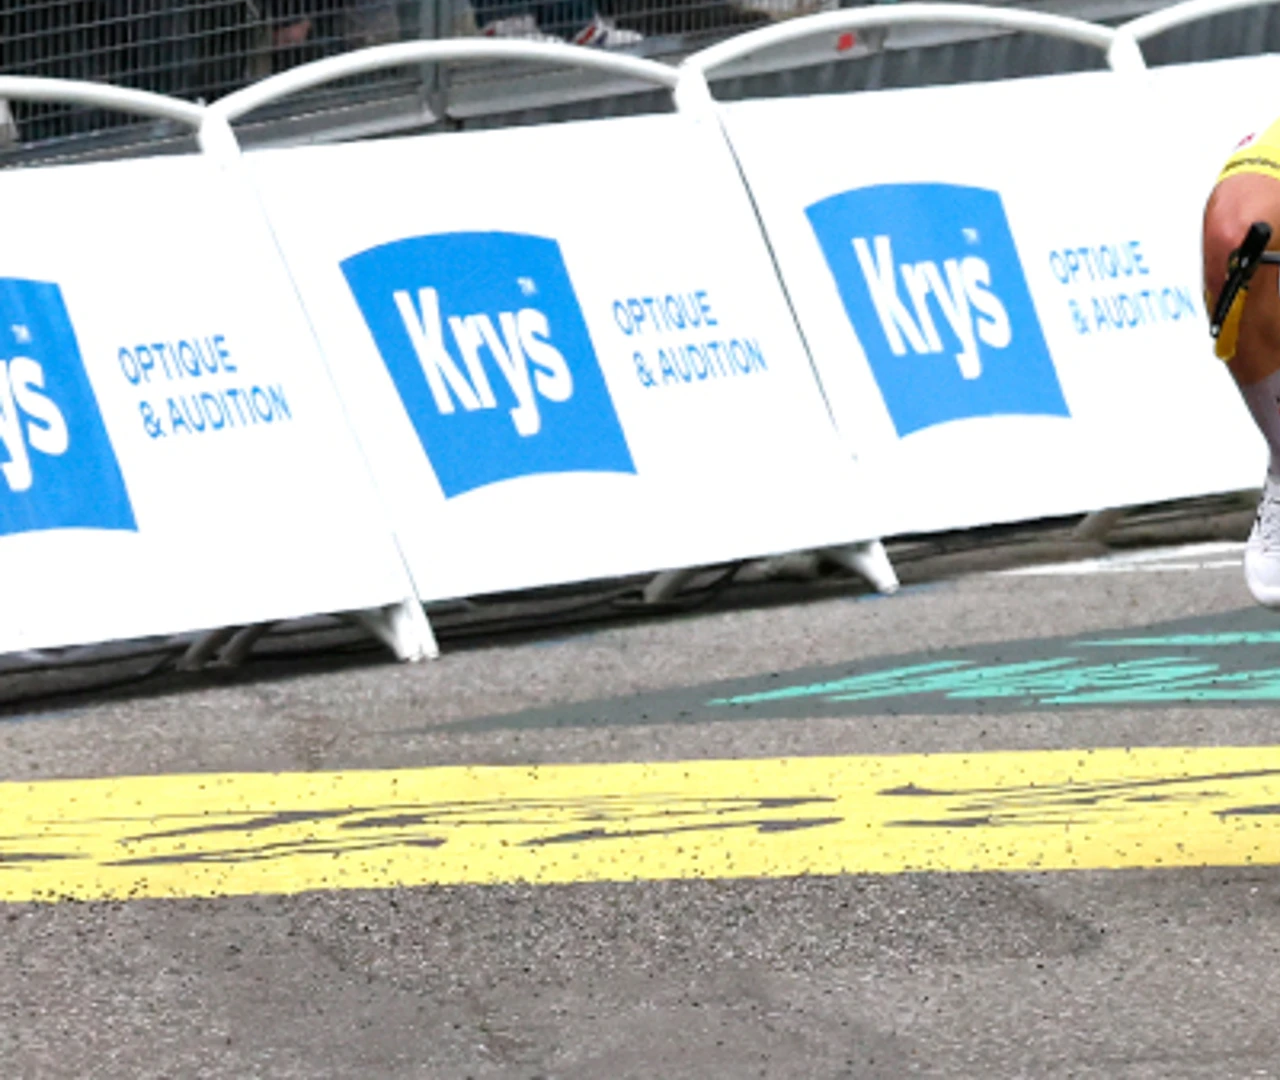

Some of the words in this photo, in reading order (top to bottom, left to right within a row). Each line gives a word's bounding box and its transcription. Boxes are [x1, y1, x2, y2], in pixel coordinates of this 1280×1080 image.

[1049, 239, 1151, 286] OPTIQUE
[612, 290, 719, 336] OPTIQUE
[852, 234, 1012, 380] Krys
[1067, 298, 1091, 336] &
[1090, 285, 1198, 331] AUDITION
[117, 333, 237, 386] OPTIQUE
[393, 286, 573, 438] Krys
[632, 350, 658, 389] &
[657, 337, 769, 386] AUDITION
[138, 399, 167, 440] &
[166, 382, 293, 436] AUDITION
